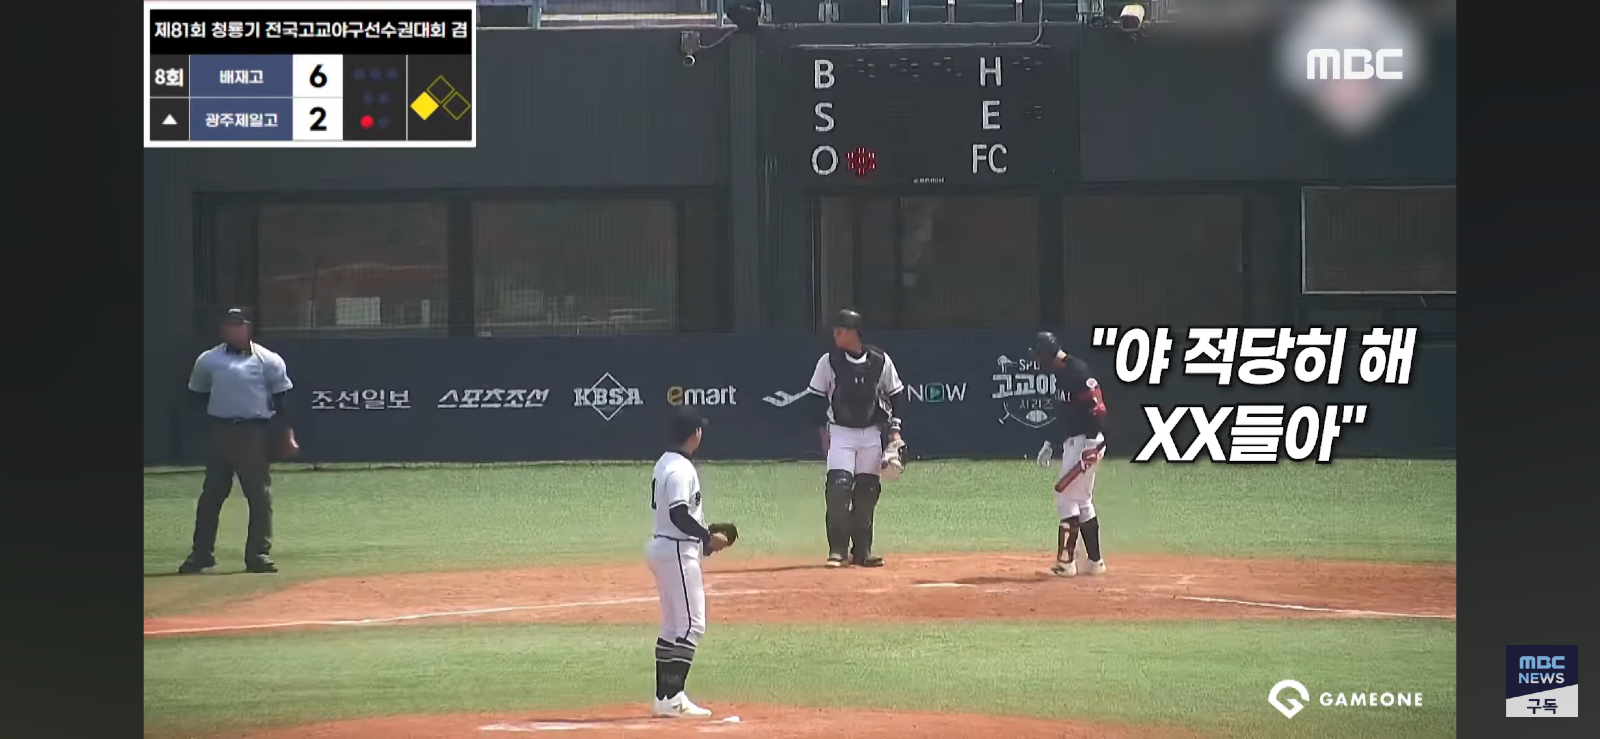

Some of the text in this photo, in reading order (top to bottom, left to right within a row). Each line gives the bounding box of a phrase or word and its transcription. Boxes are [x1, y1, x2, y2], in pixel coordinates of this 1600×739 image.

[814, 59, 836, 89] B
[979, 57, 1002, 87] H
[814, 102, 835, 132] S
[982, 100, 1001, 130] E
[811, 145, 839, 175] O
[972, 143, 1008, 173] FC
[311, 389, 412, 410] 조선일보
[437, 388, 550, 409] 스포츠조선
[573, 387, 644, 407] KBSA
[667, 385, 738, 406] emart
